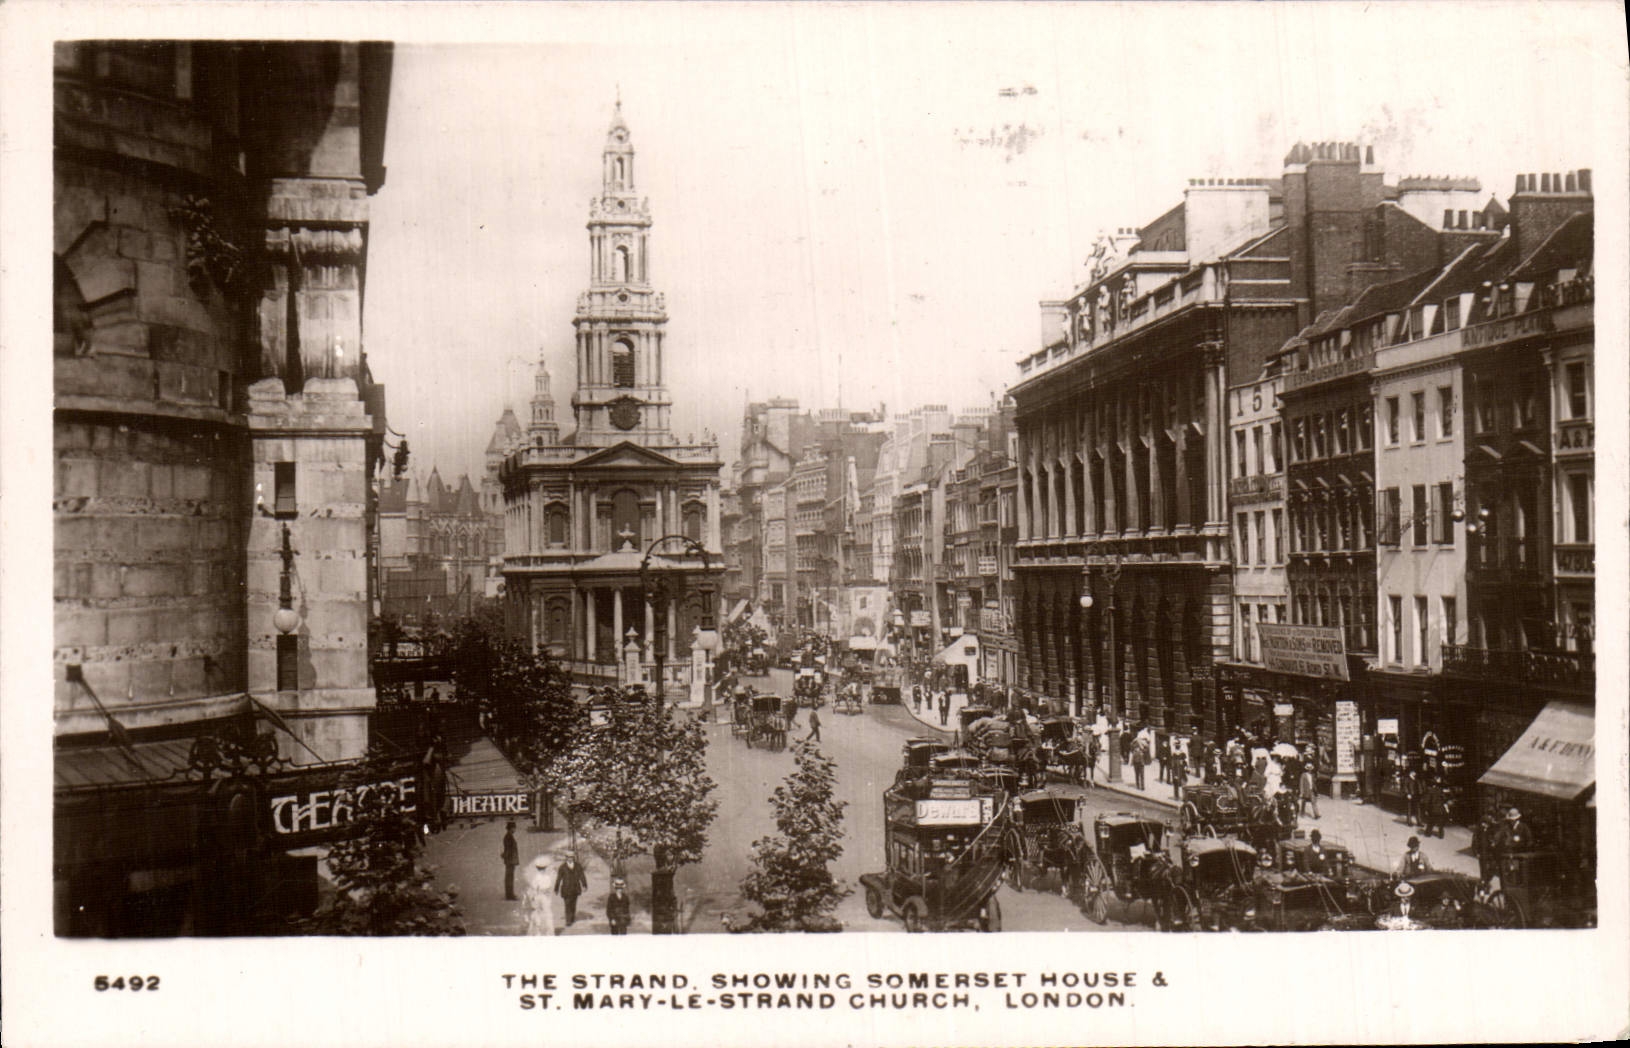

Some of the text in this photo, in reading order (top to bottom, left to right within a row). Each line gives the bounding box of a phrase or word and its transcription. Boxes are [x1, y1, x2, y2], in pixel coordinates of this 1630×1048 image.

[1237, 381, 1278, 417] 151
[1312, 637, 1343, 654] REMOVED
[450, 793, 530, 815] THEATRE
